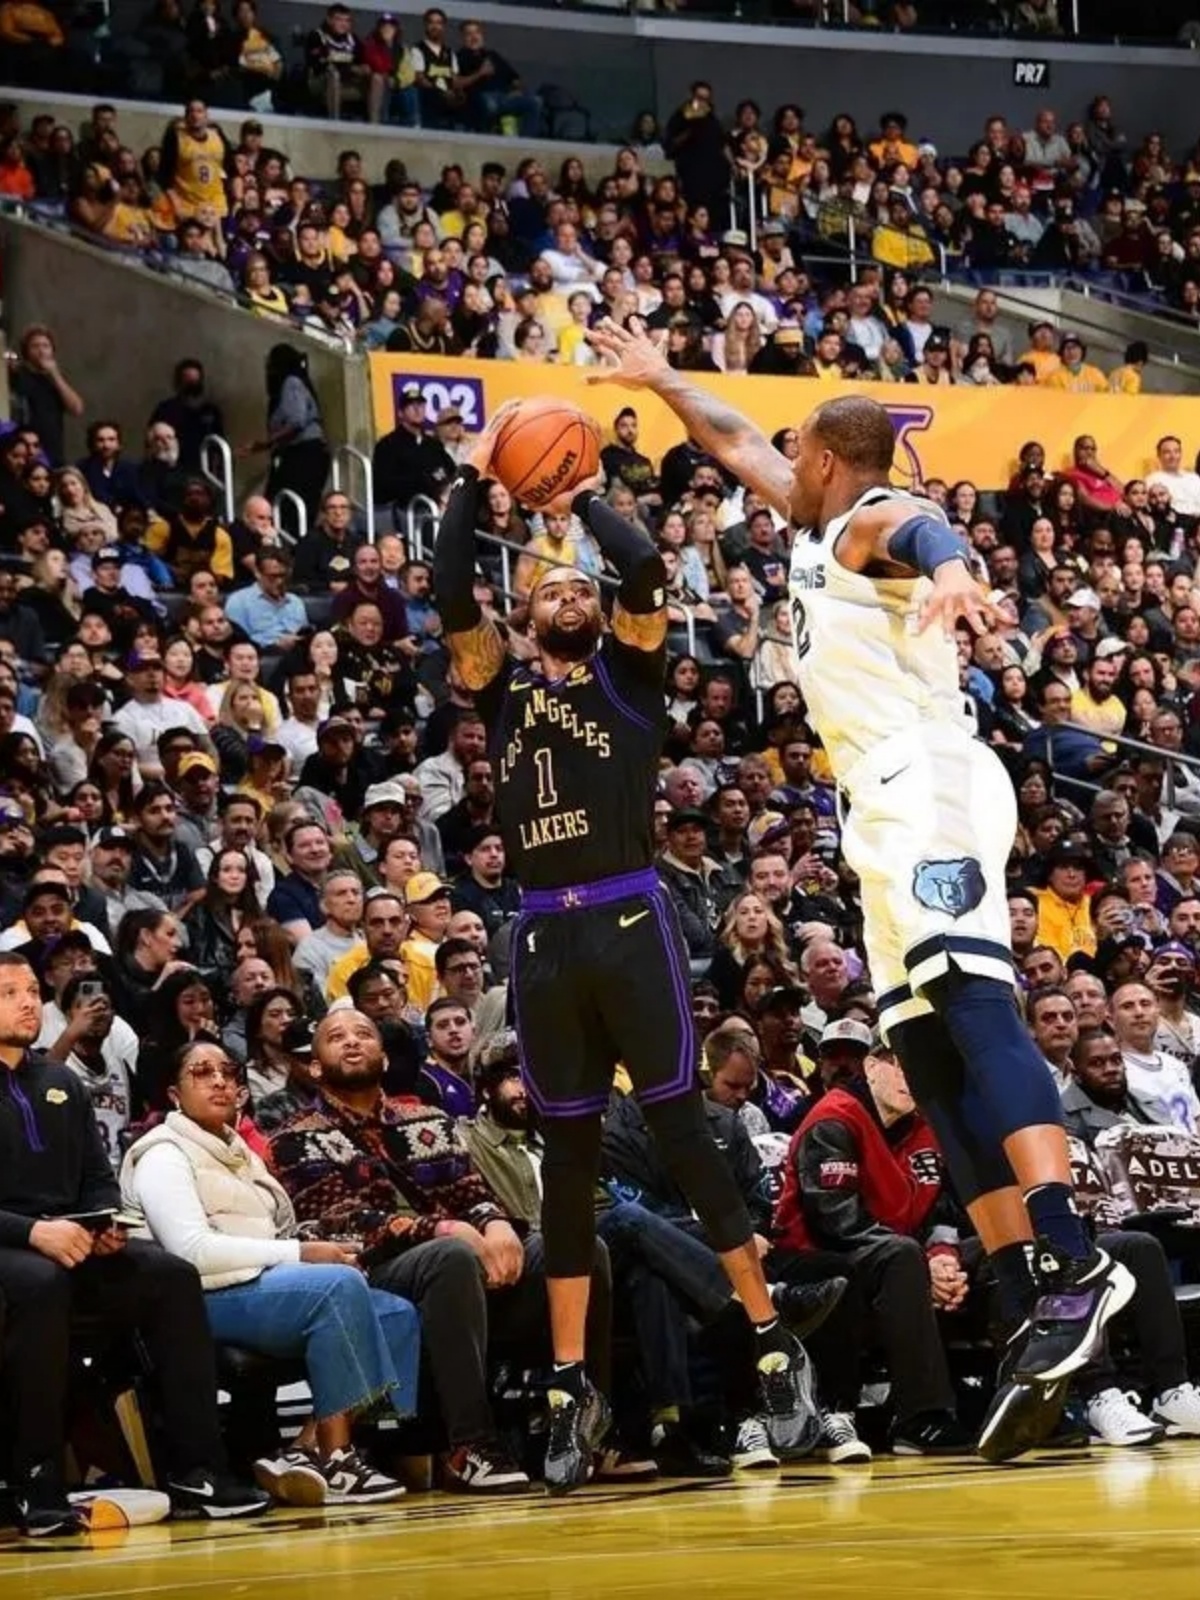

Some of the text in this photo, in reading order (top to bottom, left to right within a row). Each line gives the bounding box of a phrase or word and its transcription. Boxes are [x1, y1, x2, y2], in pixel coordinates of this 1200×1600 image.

[1015, 62, 1046, 84] PR7
[402, 381, 478, 425] 02
[500, 688, 610, 783] LOS ANGELES
[534, 747, 558, 808] 1
[519, 809, 589, 849] LAKERS
[1149, 1159, 1200, 1179] DEL
